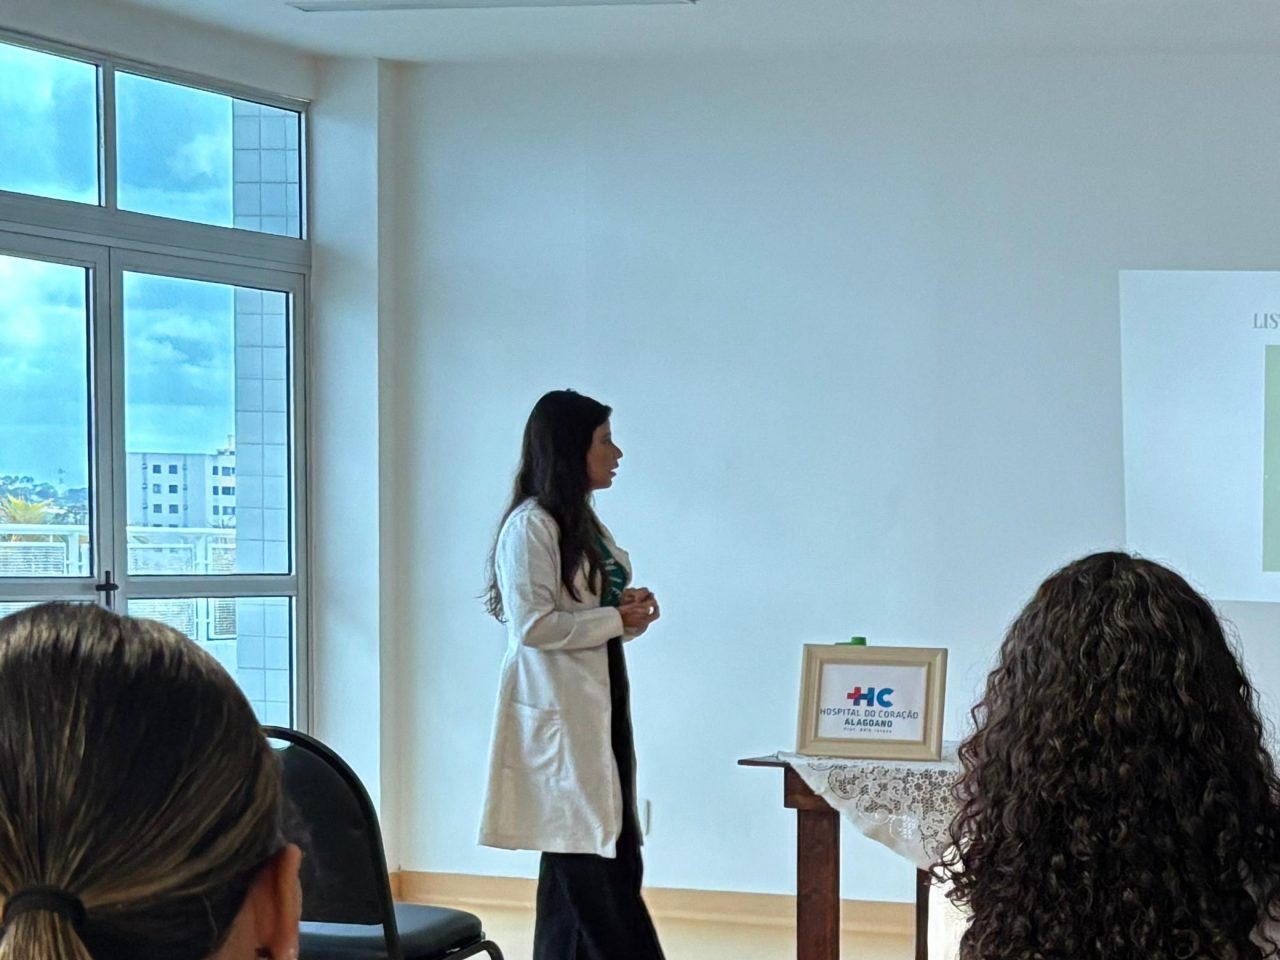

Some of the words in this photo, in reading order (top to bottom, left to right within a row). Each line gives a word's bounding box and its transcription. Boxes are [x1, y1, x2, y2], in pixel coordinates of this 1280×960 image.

[849, 686, 894, 708] HC
[820, 707, 861, 717] HOSPITAL
[864, 709, 876, 717] DO
[878, 709, 919, 720] CORAÇÃO
[844, 718, 893, 728] ALAGOANO
